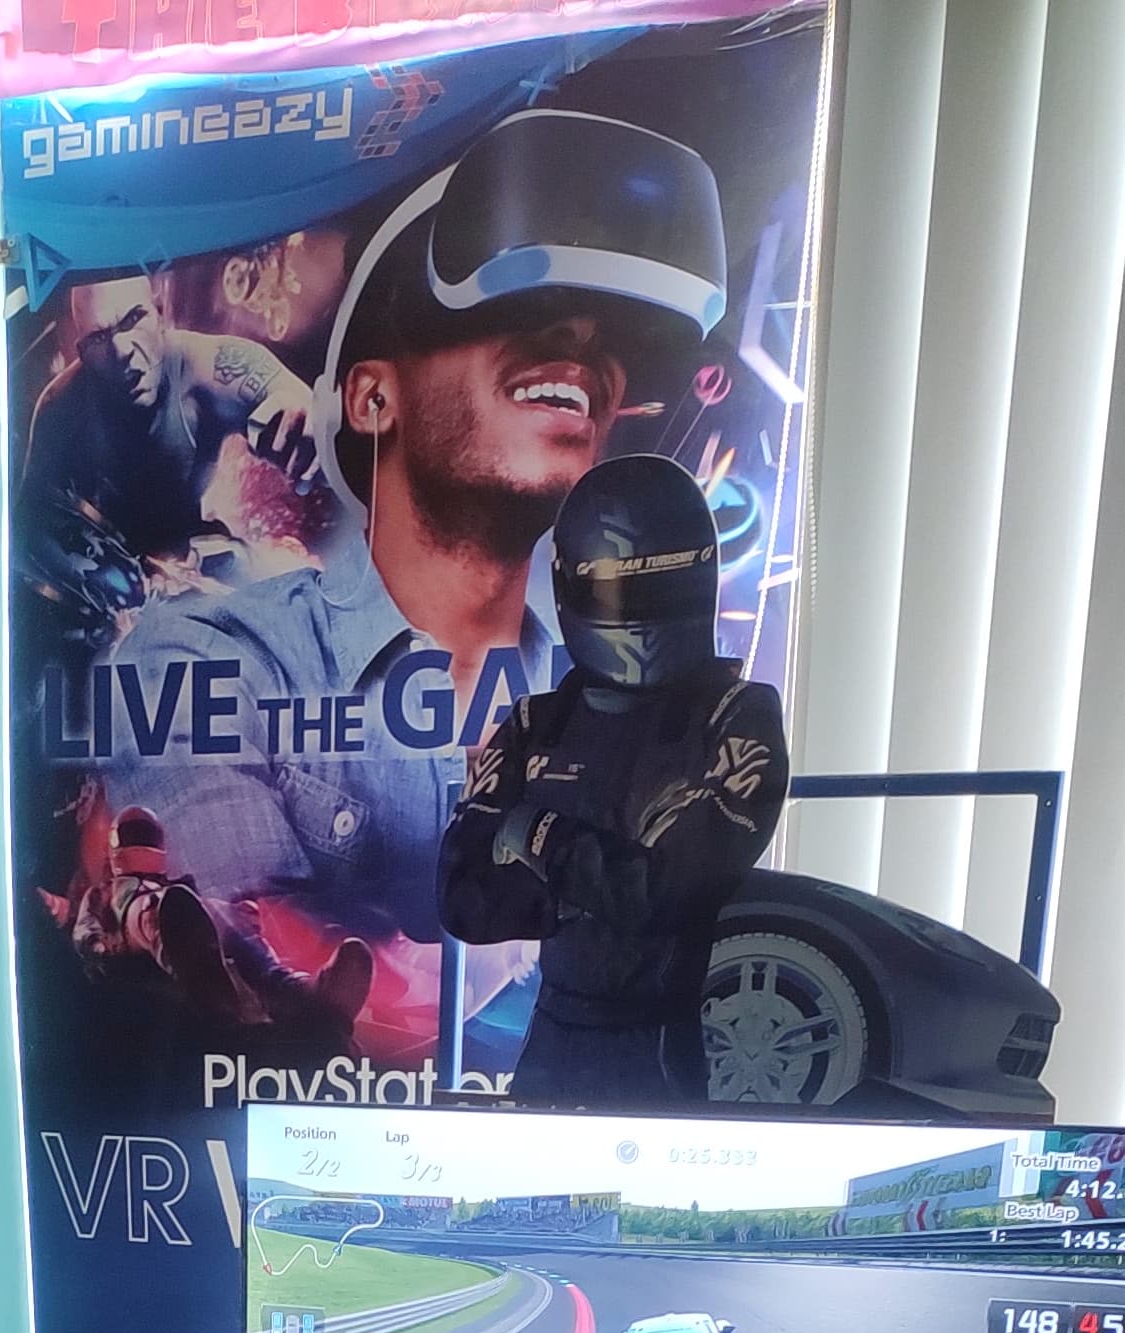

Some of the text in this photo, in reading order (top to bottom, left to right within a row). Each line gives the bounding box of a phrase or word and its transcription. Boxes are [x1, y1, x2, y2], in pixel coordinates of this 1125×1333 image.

[21, 87, 353, 180] gamineazy
[43, 645, 572, 759] LIVE THE GA
[284, 1126, 410, 1146] Position Lap
[297, 1149, 443, 1183] 2/2 3/3
[1011, 1153, 1100, 1171] Total Time
[41, 1131, 193, 1247] VR
[1006, 1204, 1078, 1223] Best Lap
